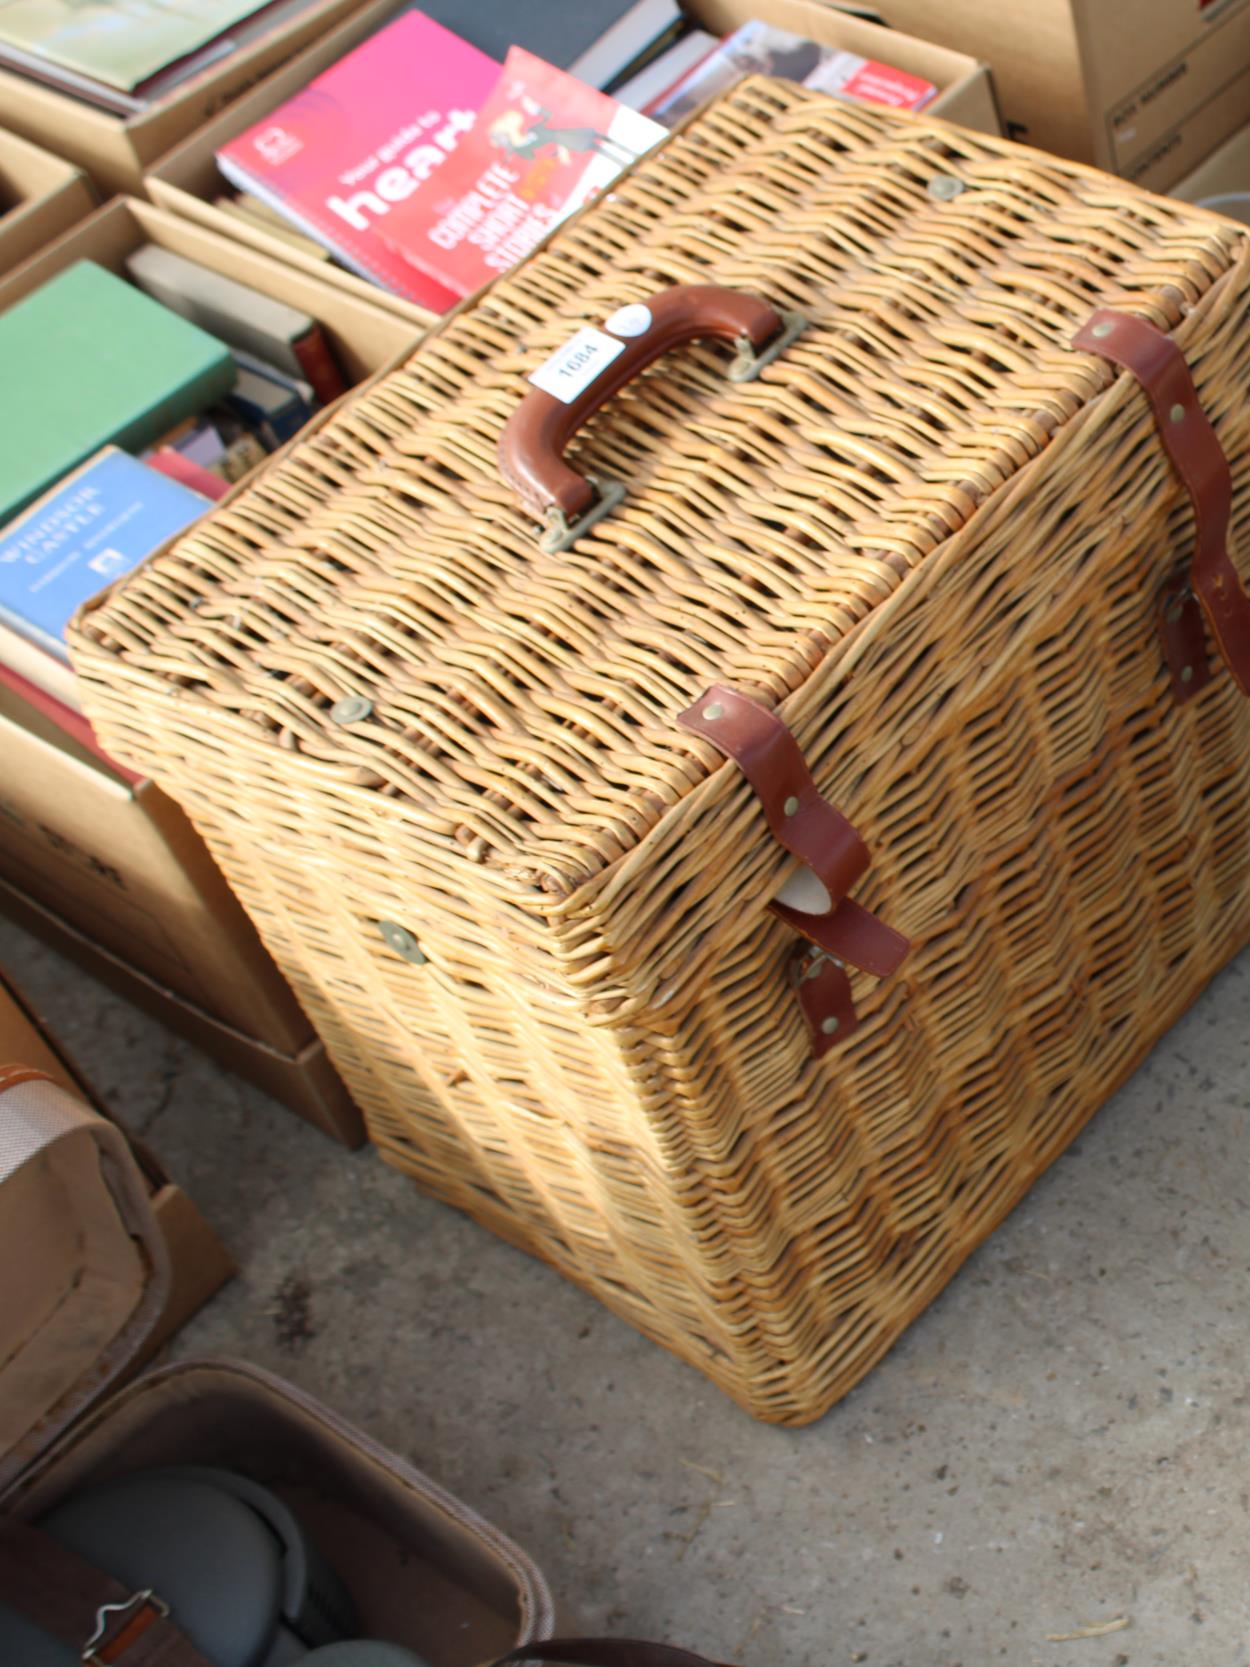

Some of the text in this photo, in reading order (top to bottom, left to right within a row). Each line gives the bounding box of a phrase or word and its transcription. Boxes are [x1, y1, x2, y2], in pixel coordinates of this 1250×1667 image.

[326, 108, 477, 231] heart
[427, 160, 520, 250] COMPLETE
[467, 191, 531, 251] SHORT
[558, 343, 599, 378] 1684
